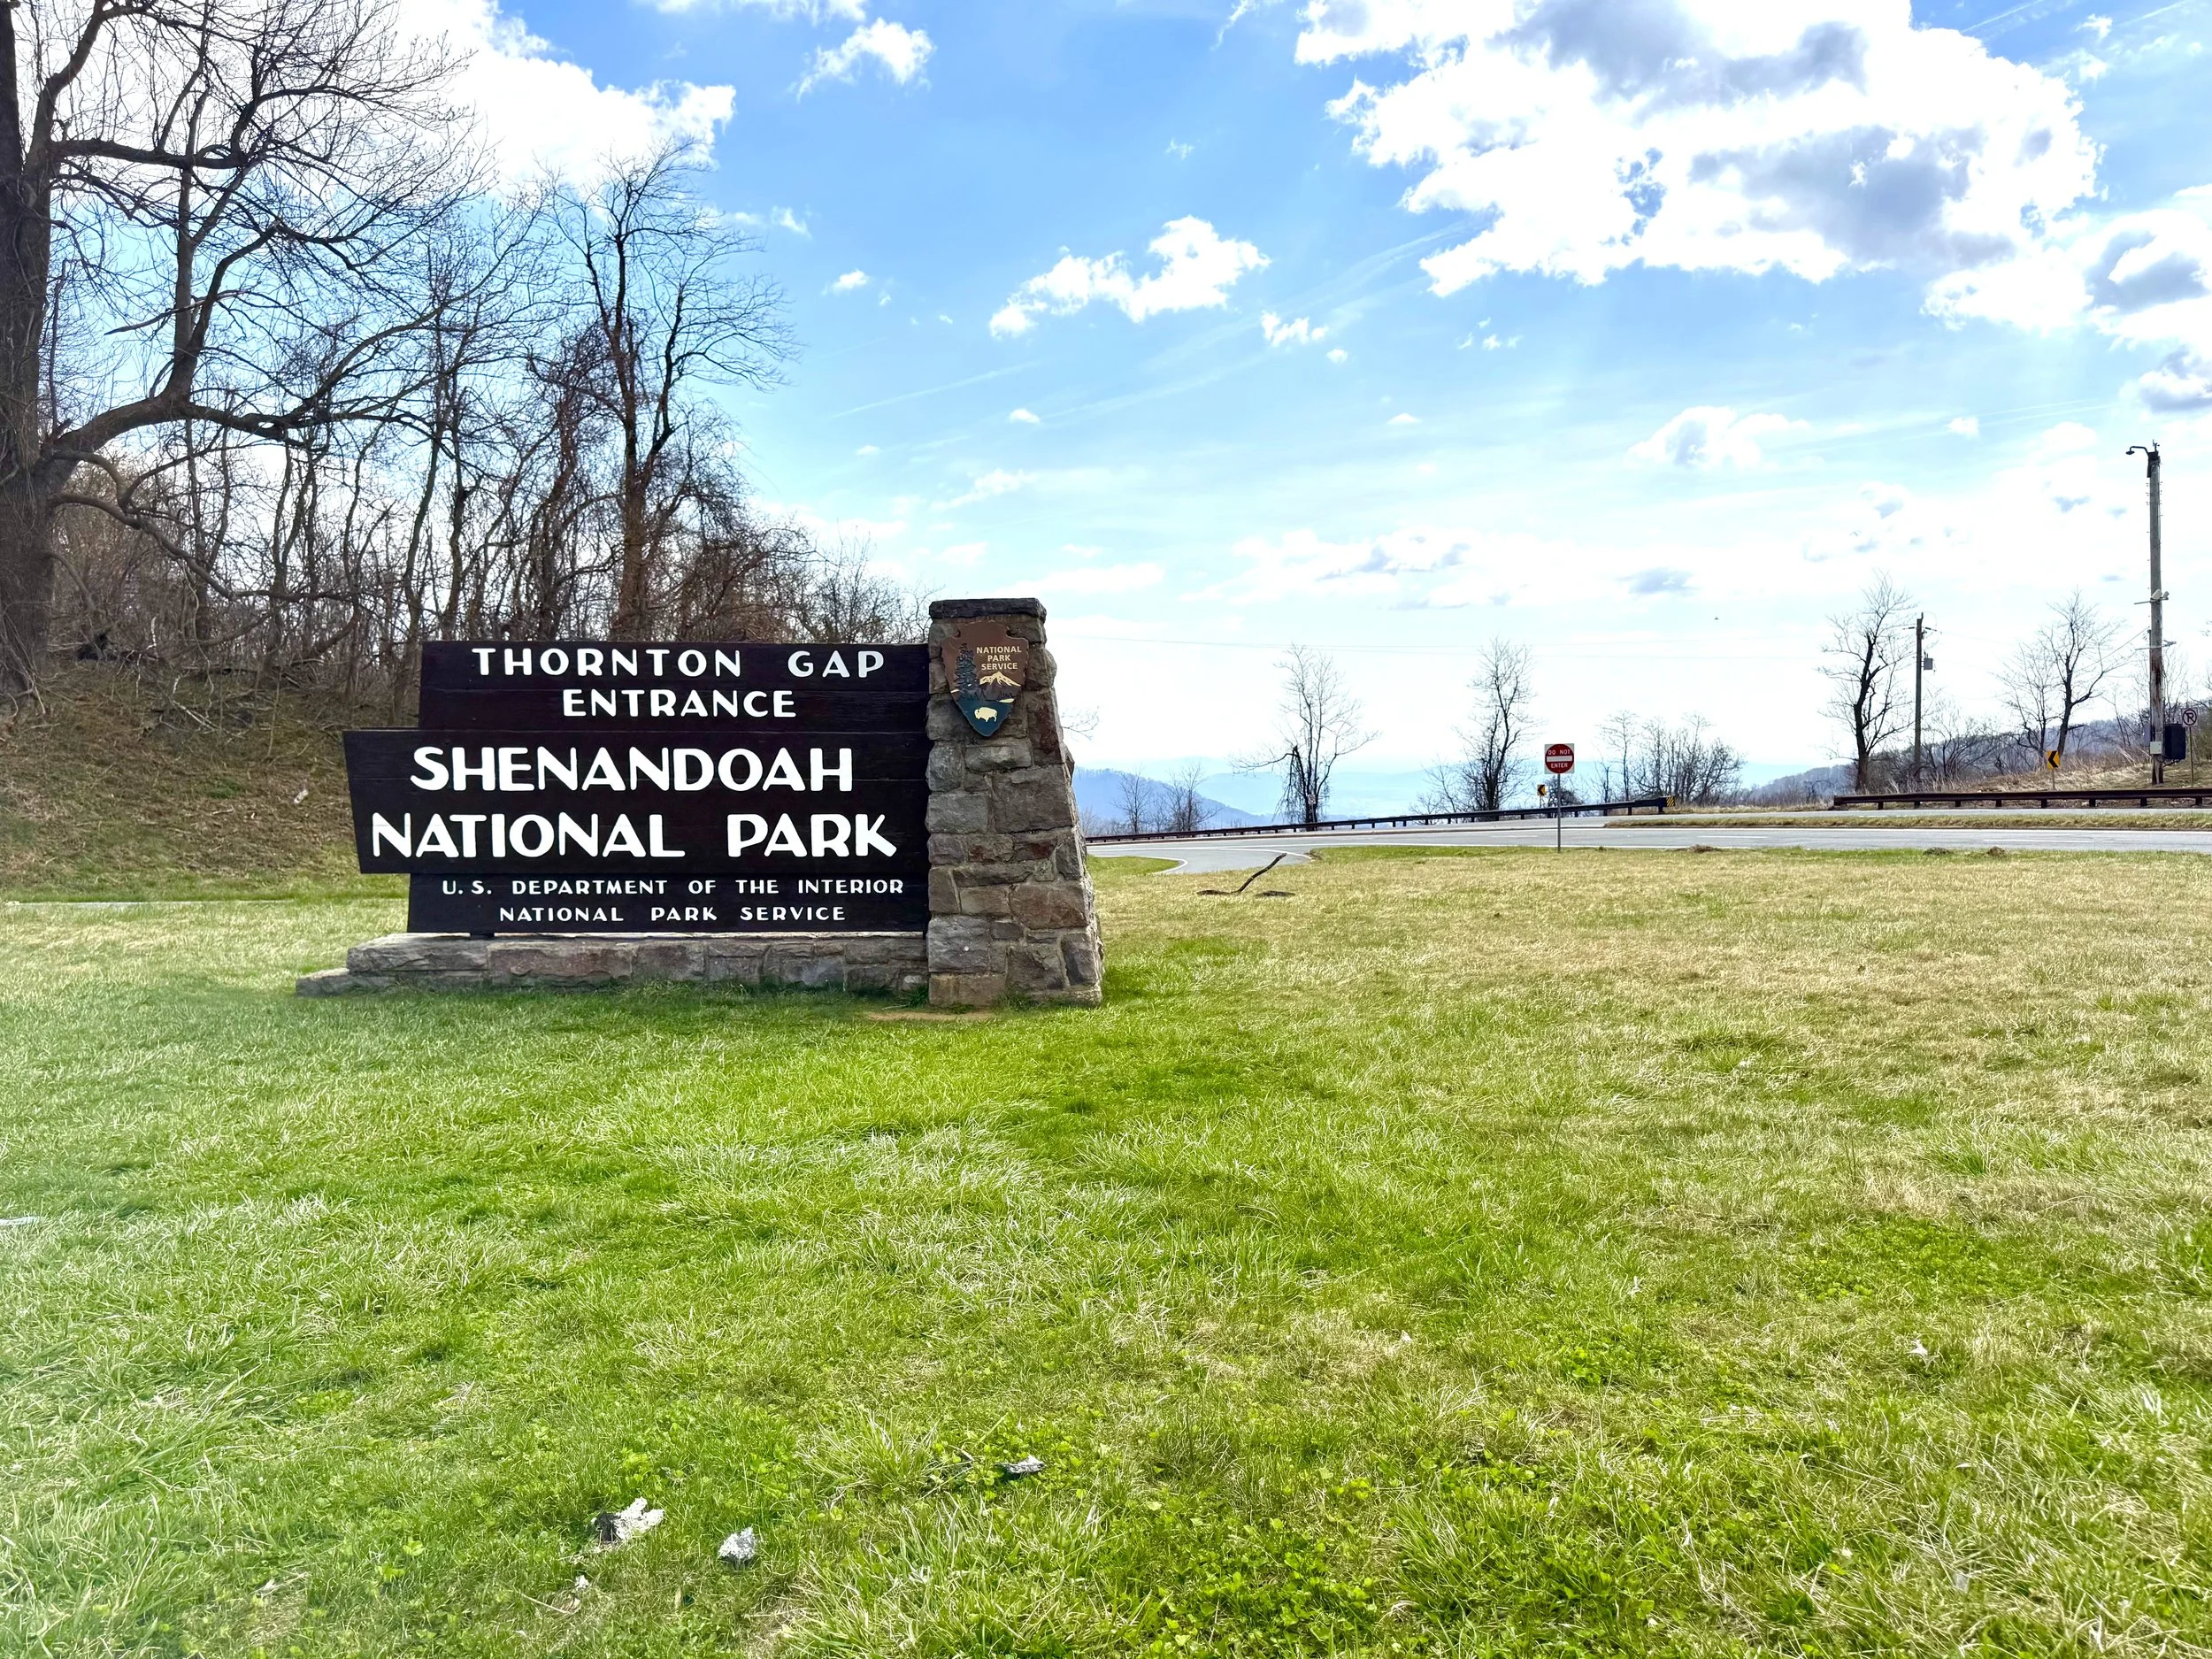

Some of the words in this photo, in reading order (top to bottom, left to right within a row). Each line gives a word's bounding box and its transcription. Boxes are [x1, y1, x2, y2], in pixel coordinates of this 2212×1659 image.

[472, 649, 741, 677] THORNTON
[787, 650, 885, 678] GAP
[981, 662, 1018, 671] SERVICE
[563, 689, 796, 718] ENTRANCE
[410, 747, 853, 792] SHENANDOAH
[372, 812, 686, 857] NATIONAL
[726, 813, 897, 857] PARK
[511, 880, 667, 895] DEPARTMENT
[688, 880, 717, 895] OF
[735, 879, 780, 895] THE
[798, 879, 903, 894] INTERIOR
[500, 907, 624, 921] NATIONAL
[650, 907, 718, 921] PARK
[741, 907, 846, 921] SERVICE
